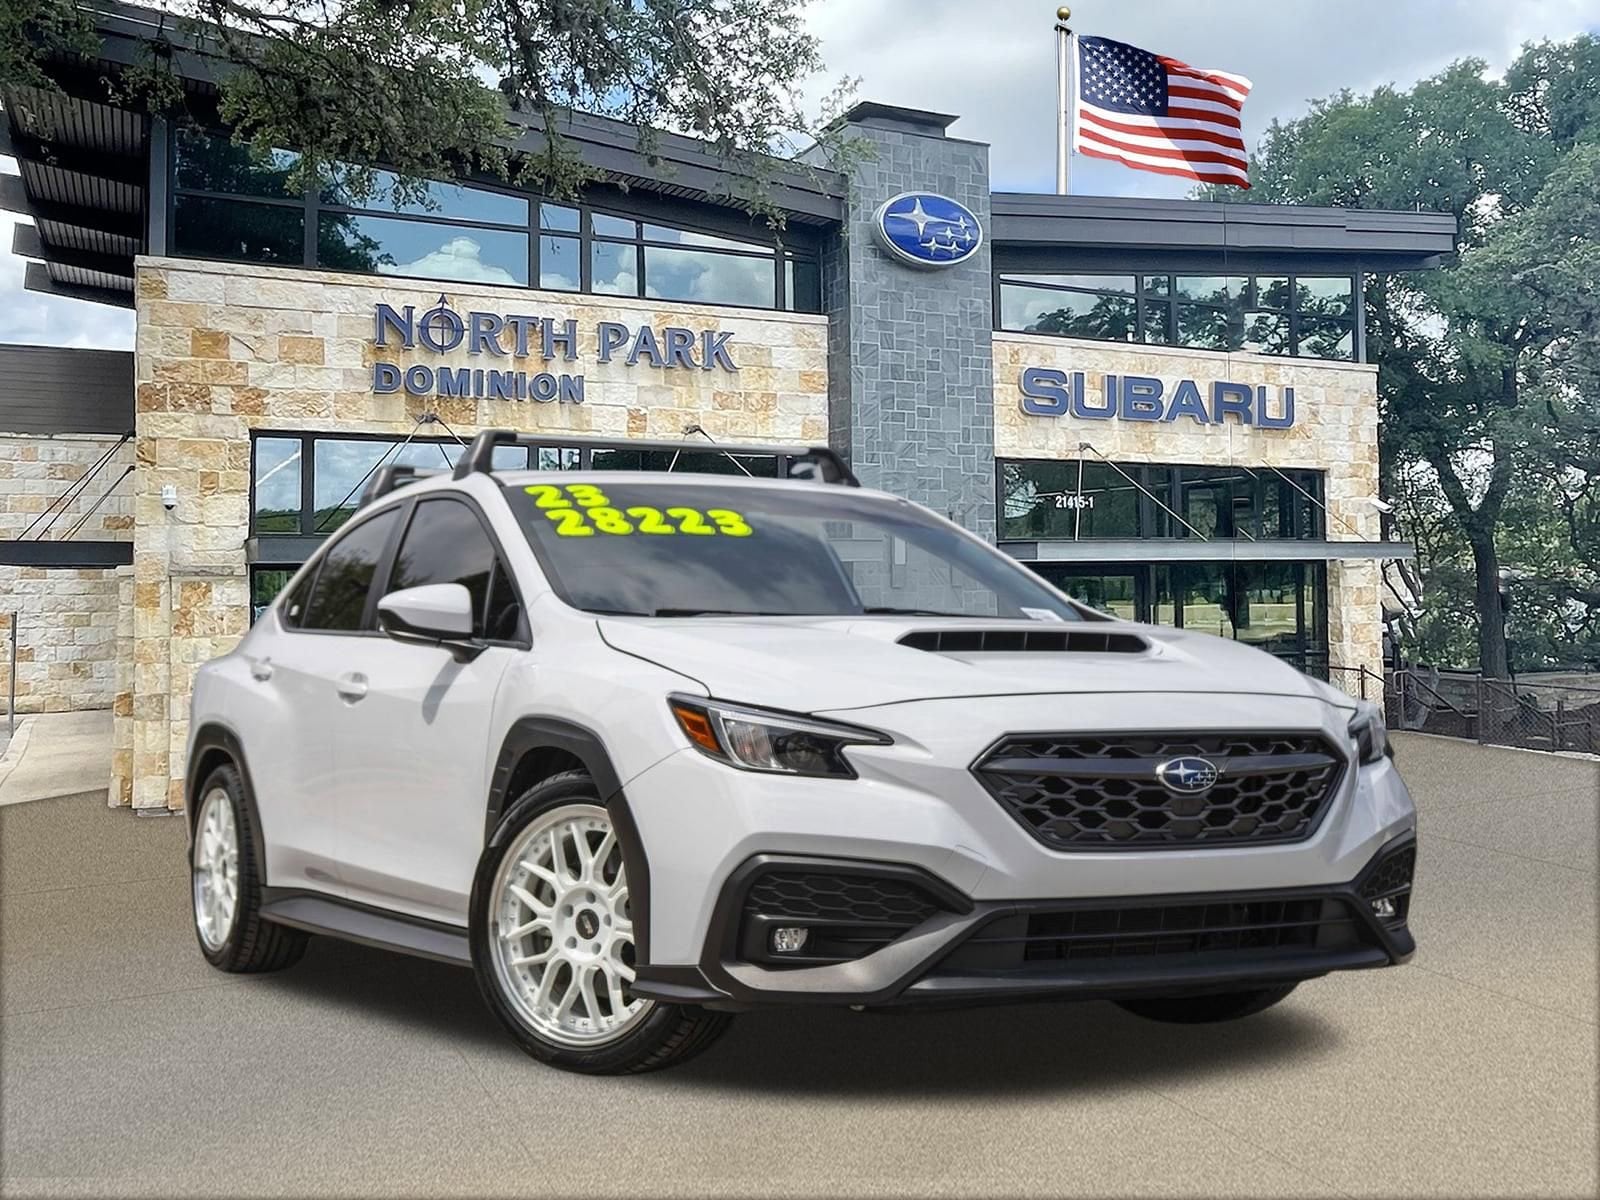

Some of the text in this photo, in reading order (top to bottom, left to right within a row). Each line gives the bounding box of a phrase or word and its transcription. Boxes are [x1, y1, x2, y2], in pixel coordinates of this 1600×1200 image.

[375, 293, 740, 373] NORTH PARK
[373, 362, 585, 404] DOMINION
[1019, 367, 1294, 430] SUBARU
[524, 484, 610, 508] 23
[545, 507, 753, 536] 28223
